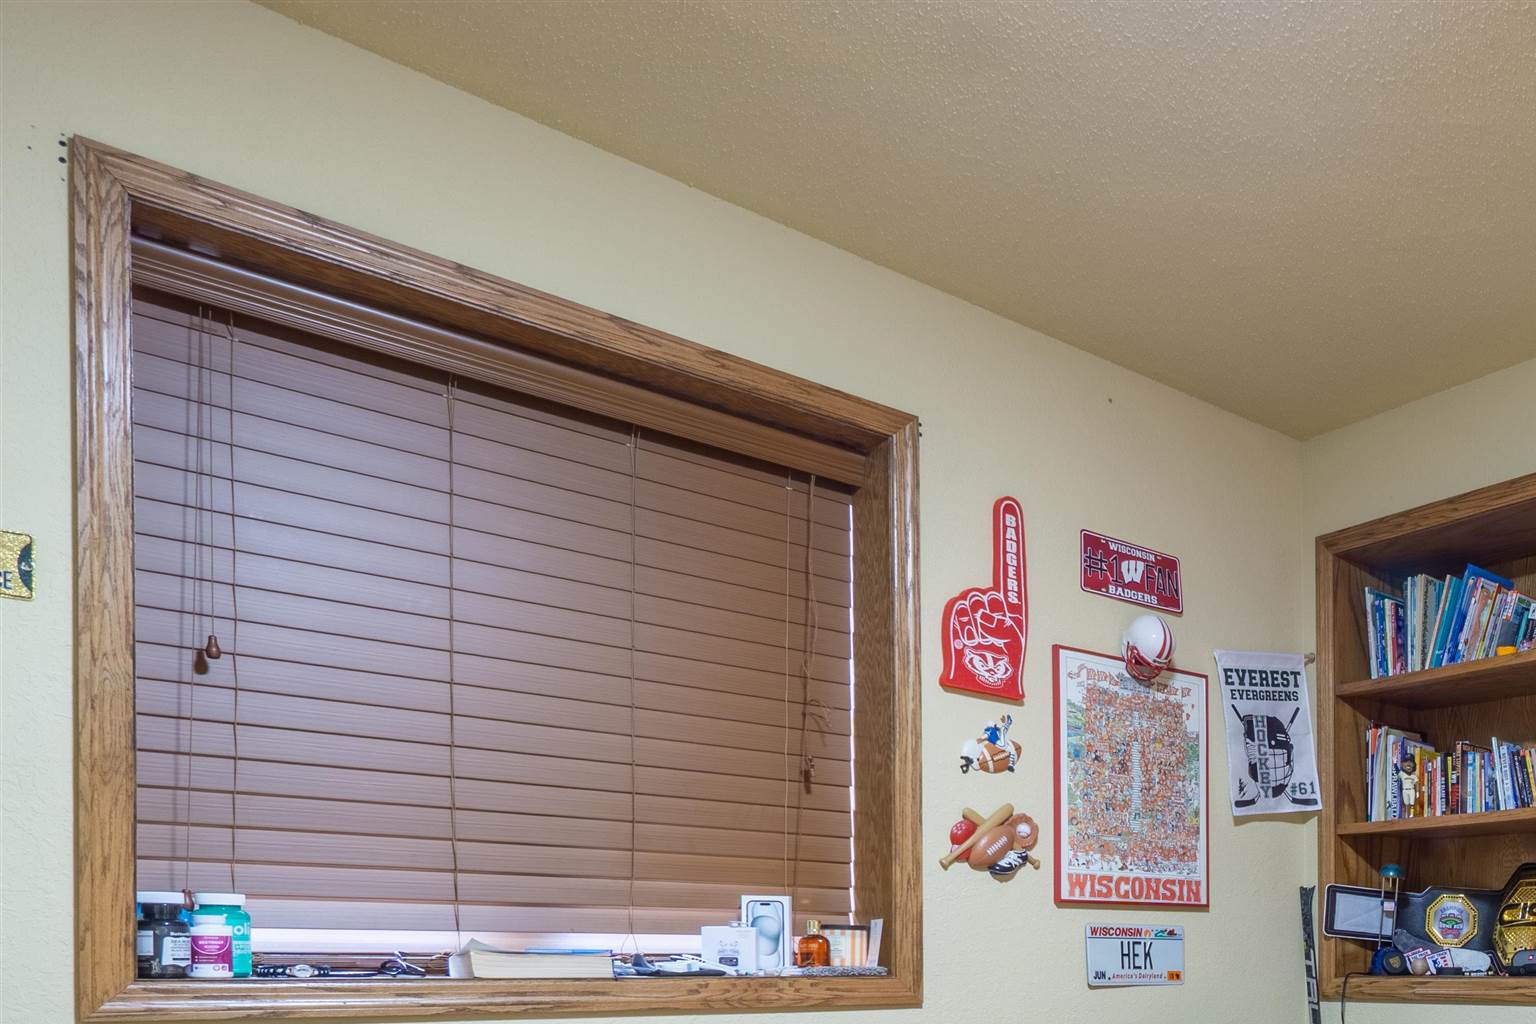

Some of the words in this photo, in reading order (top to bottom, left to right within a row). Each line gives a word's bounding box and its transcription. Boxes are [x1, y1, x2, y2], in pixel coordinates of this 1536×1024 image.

[1005, 513, 1018, 605] BADGERS
[1108, 541, 1155, 562] WISCONSIN
[1144, 562, 1180, 599] FAN
[1108, 584, 1158, 605] BADGERS
[1223, 668, 1301, 688] EVEREST
[1230, 689, 1299, 702] EVERGREENS
[1254, 715, 1273, 799] HOCKEY
[1290, 780, 1317, 796] #61
[1067, 872, 1202, 903] WISCONSIN
[1090, 926, 1143, 937] WISCONSIN
[1120, 940, 1153, 970] HEK
[1093, 971, 1106, 980] JUN
[1112, 972, 1138, 980] America's
